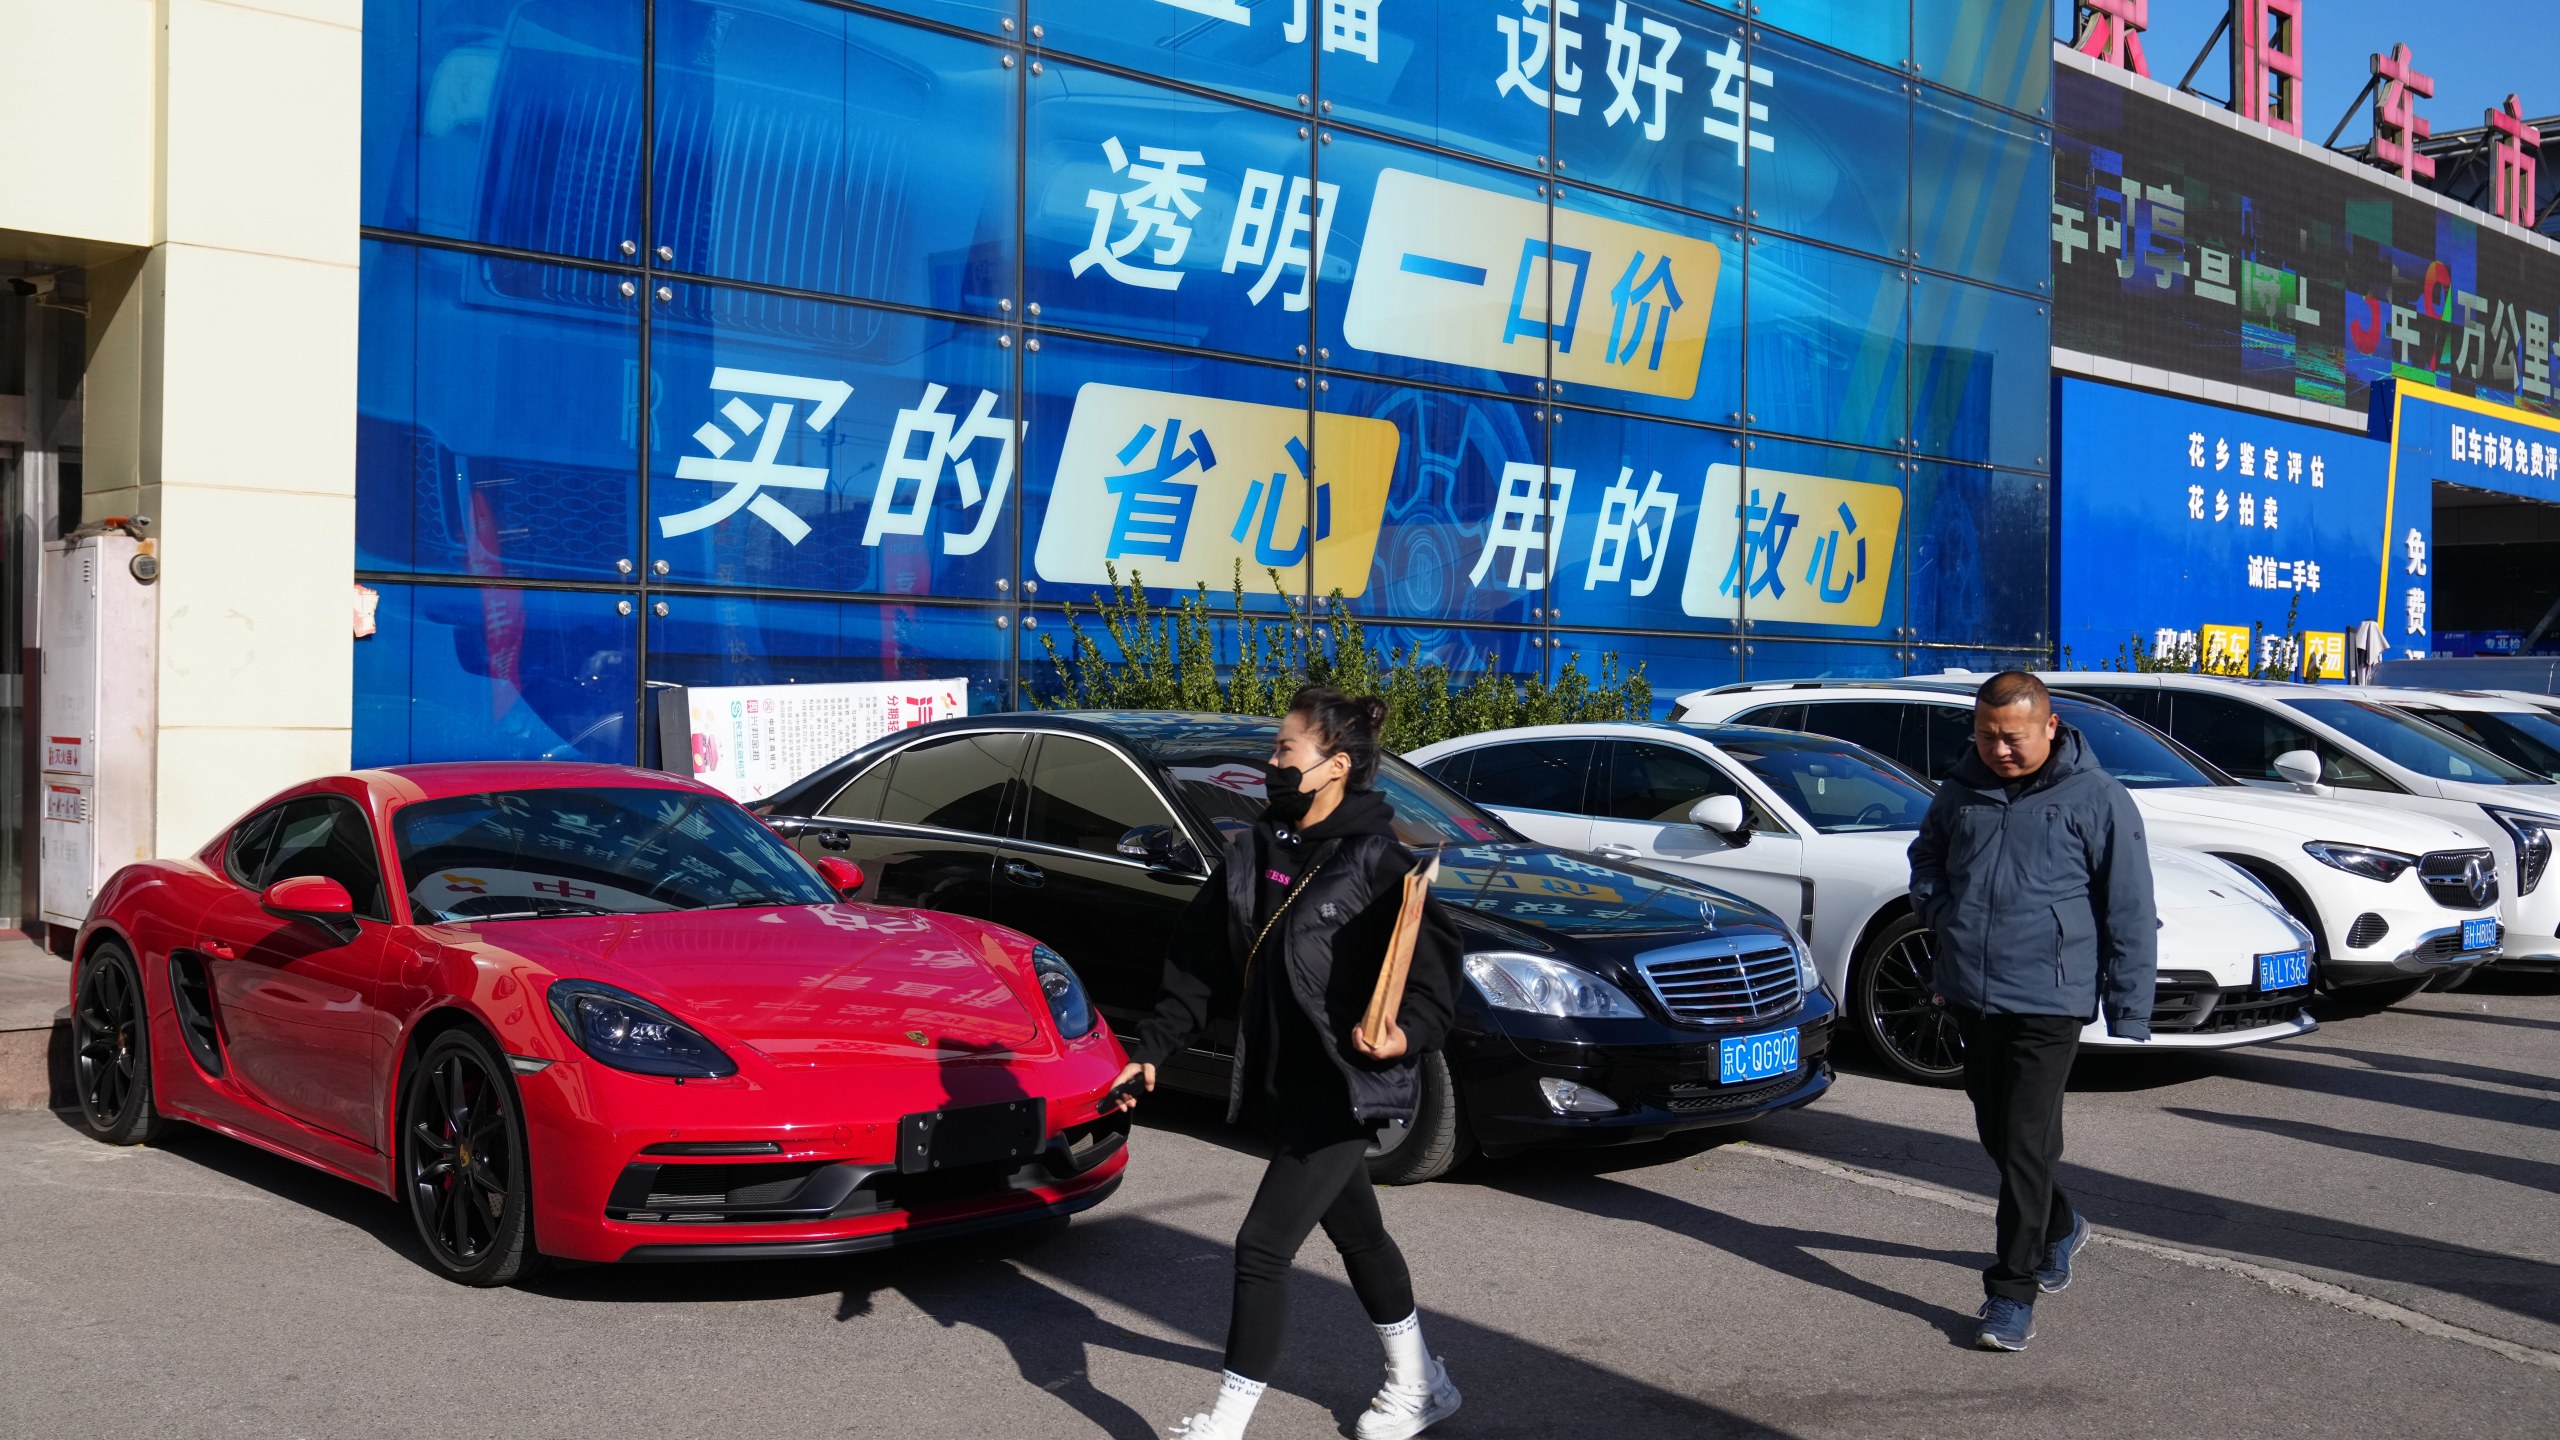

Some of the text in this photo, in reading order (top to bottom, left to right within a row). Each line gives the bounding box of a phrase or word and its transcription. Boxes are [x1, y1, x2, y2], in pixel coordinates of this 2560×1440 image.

[1497, 0, 1774, 167] 选好车
[1070, 135, 1683, 371] 透明 一口价
[2188, 432, 2325, 489] 花乡鉴定评估
[2451, 424, 2560, 481] 旧车市场免费评
[659, 366, 1867, 603] 买的 省心 用的 放心
[2187, 485, 2279, 530] 花乡拍卖
[2248, 555, 2321, 593] 诚信二手车
[2406, 527, 2427, 659] 免费
[2308, 636, 2342, 671] 交易
[2485, 638, 2527, 649] 专业检
[2261, 955, 2307, 986] 京A·LY363
[1723, 1034, 1797, 1076] 京C·QG902
